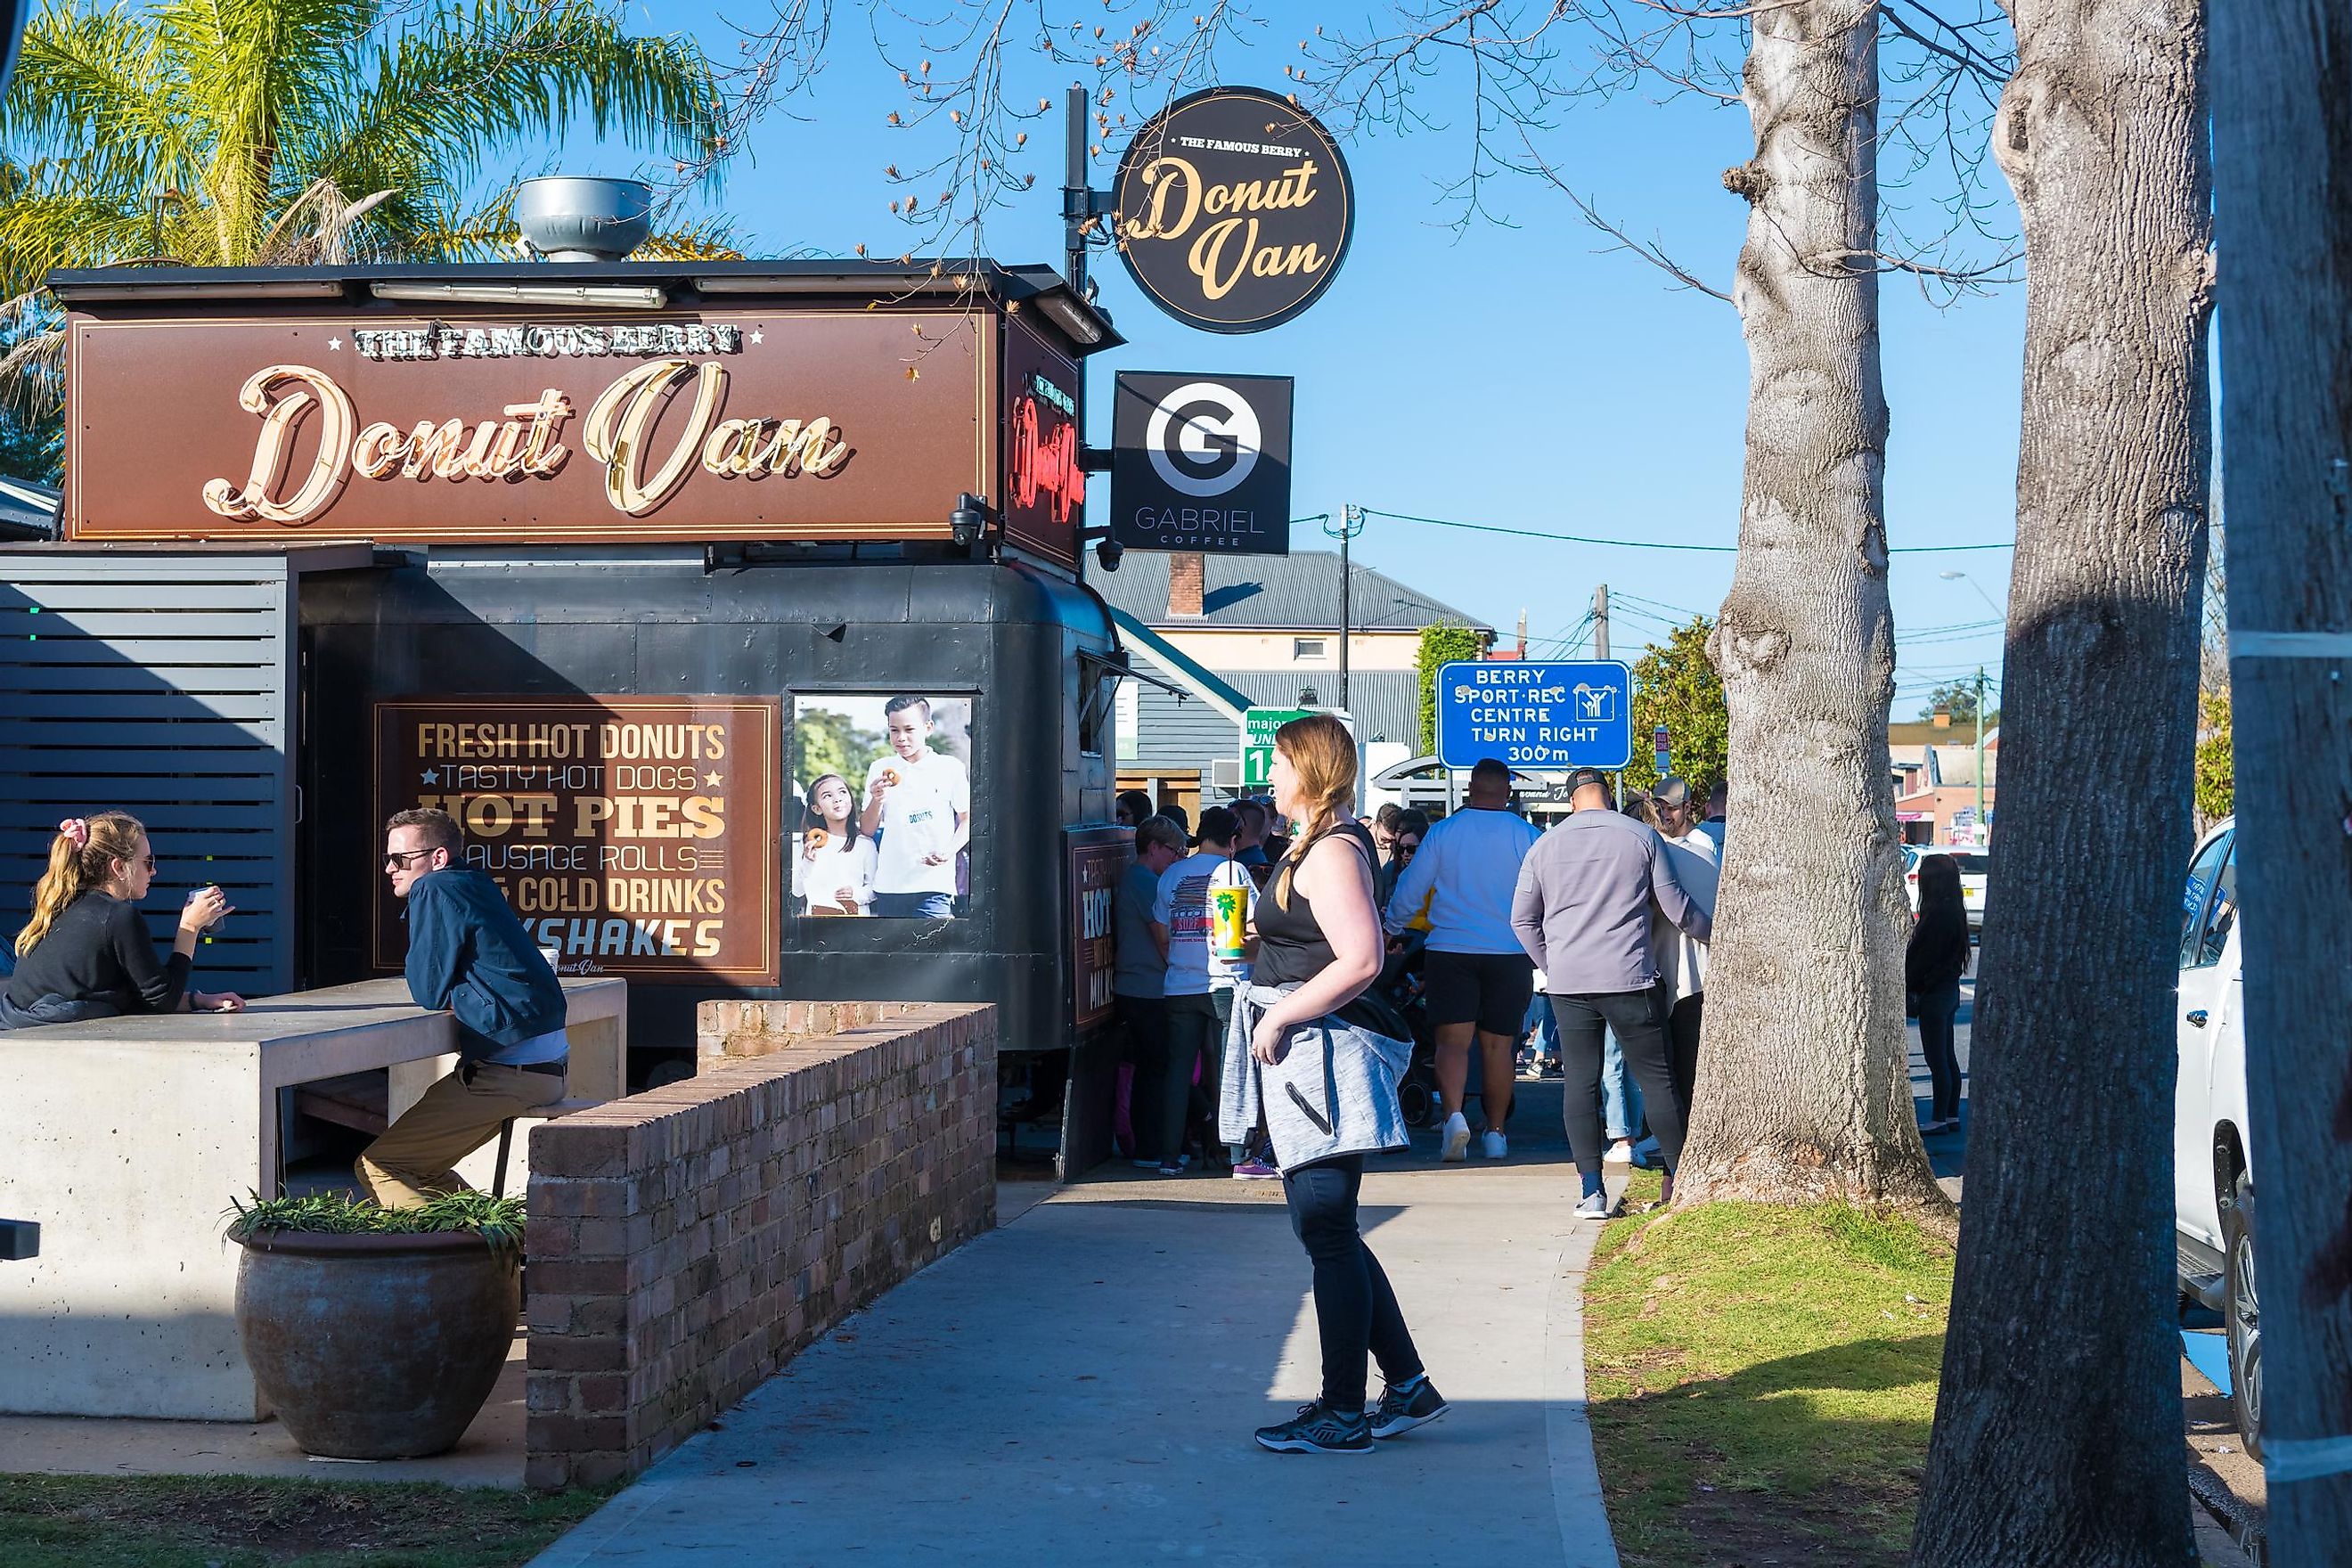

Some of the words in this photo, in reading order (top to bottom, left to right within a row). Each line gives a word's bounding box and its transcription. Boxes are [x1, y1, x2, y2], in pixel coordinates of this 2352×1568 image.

[1180, 136, 1205, 150] THE
[1206, 138, 1260, 155] FAMOUS
[1261, 144, 1303, 159] BERRY
[1125, 157, 1319, 241] Donut
[1188, 217, 1327, 300] Van
[356, 328, 432, 358] THE
[441, 326, 607, 357] FAMOUS
[610, 324, 740, 355] BERRY
[202, 363, 569, 523] Donut
[583, 359, 847, 513] Van
[1135, 506, 1266, 534] GABRIEL
[1160, 535, 1240, 546] COFFEE
[1475, 669, 1546, 684] BERRY
[1454, 685, 1520, 704] SPORT
[1527, 686, 1566, 704] REC
[1471, 707, 1550, 723] CENTRE
[418, 723, 518, 758] FRESH
[528, 723, 591, 758] HOT
[600, 723, 726, 760] DONUTS
[1471, 727, 1526, 742] TURN
[1539, 727, 1598, 742] RIGHT
[1507, 746, 1549, 762] 300
[1552, 748, 1569, 762] m
[440, 764, 536, 789] TASTY
[547, 765, 606, 789] HOT
[616, 765, 698, 790] DOGS
[574, 796, 726, 839] PIES
[466, 844, 587, 870] AUSAGE
[600, 845, 698, 871] ROLLS
[518, 877, 599, 912] COLD
[608, 878, 726, 914] DRINKS
[1082, 888, 1112, 940] HOT
[519, 918, 724, 957] SHAKES
